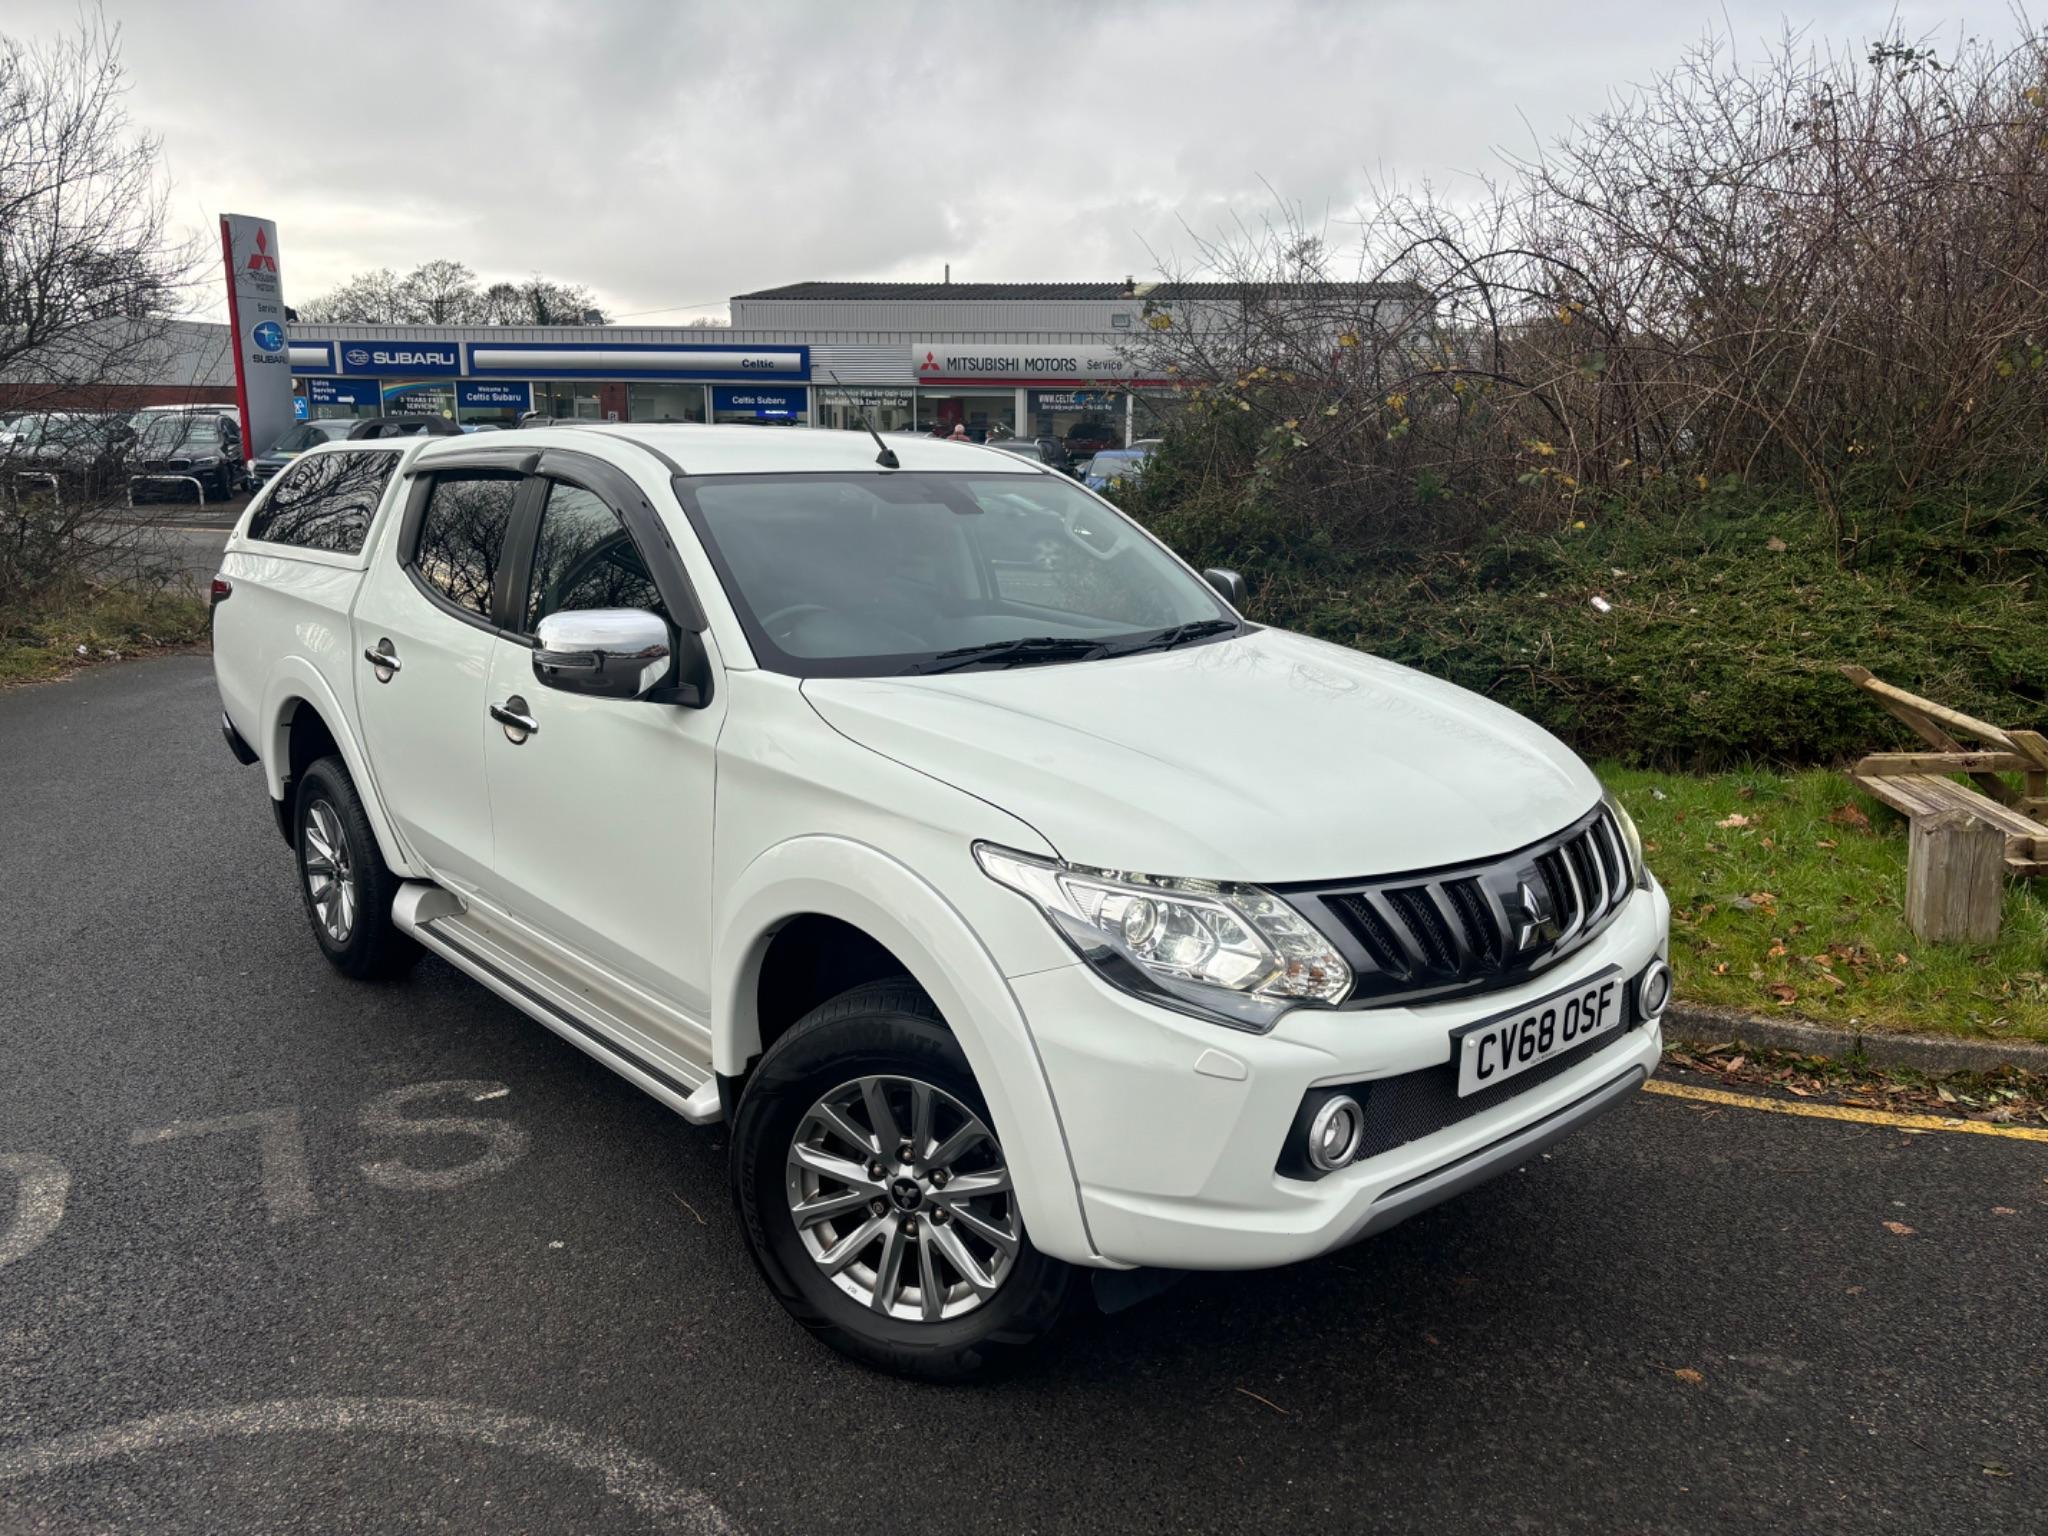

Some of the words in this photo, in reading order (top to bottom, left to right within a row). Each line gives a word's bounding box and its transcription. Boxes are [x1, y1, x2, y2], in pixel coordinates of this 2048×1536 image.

[373, 351, 455, 366] SUBARU
[742, 358, 775, 369] Celtic
[946, 357, 1019, 372] MITSUBISHI
[1025, 357, 1077, 372] MOTORS
[1086, 359, 1122, 371] Service
[466, 392, 490, 401] Celtic
[492, 392, 522, 401] Subaru
[732, 395, 756, 405] Celtic
[756, 395, 786, 405] Subaru
[1477, 1008, 1556, 1080] CV68
[1562, 981, 1614, 1042] OSF
